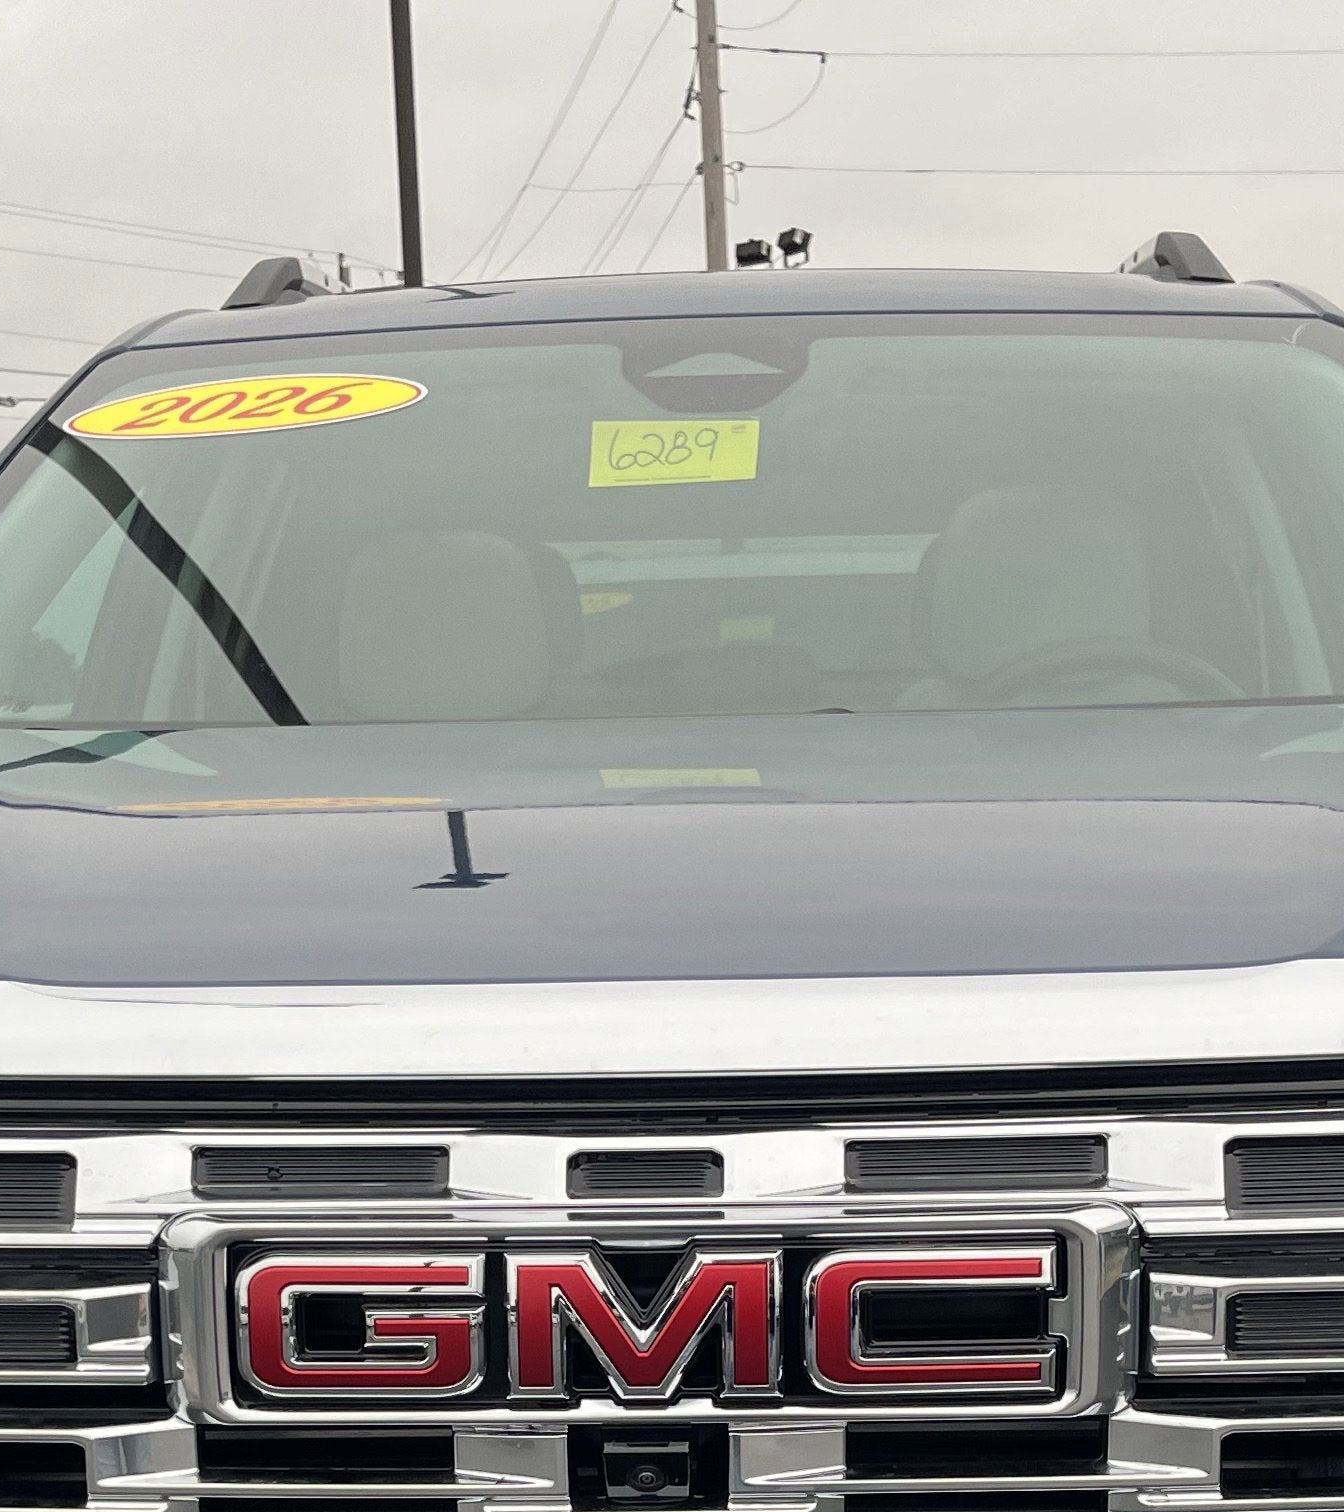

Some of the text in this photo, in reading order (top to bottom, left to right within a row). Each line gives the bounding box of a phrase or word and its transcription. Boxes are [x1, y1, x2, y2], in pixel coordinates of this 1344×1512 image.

[112, 382, 374, 432] 2026
[608, 427, 720, 471] 6289
[234, 1244, 1058, 1401] GMC
